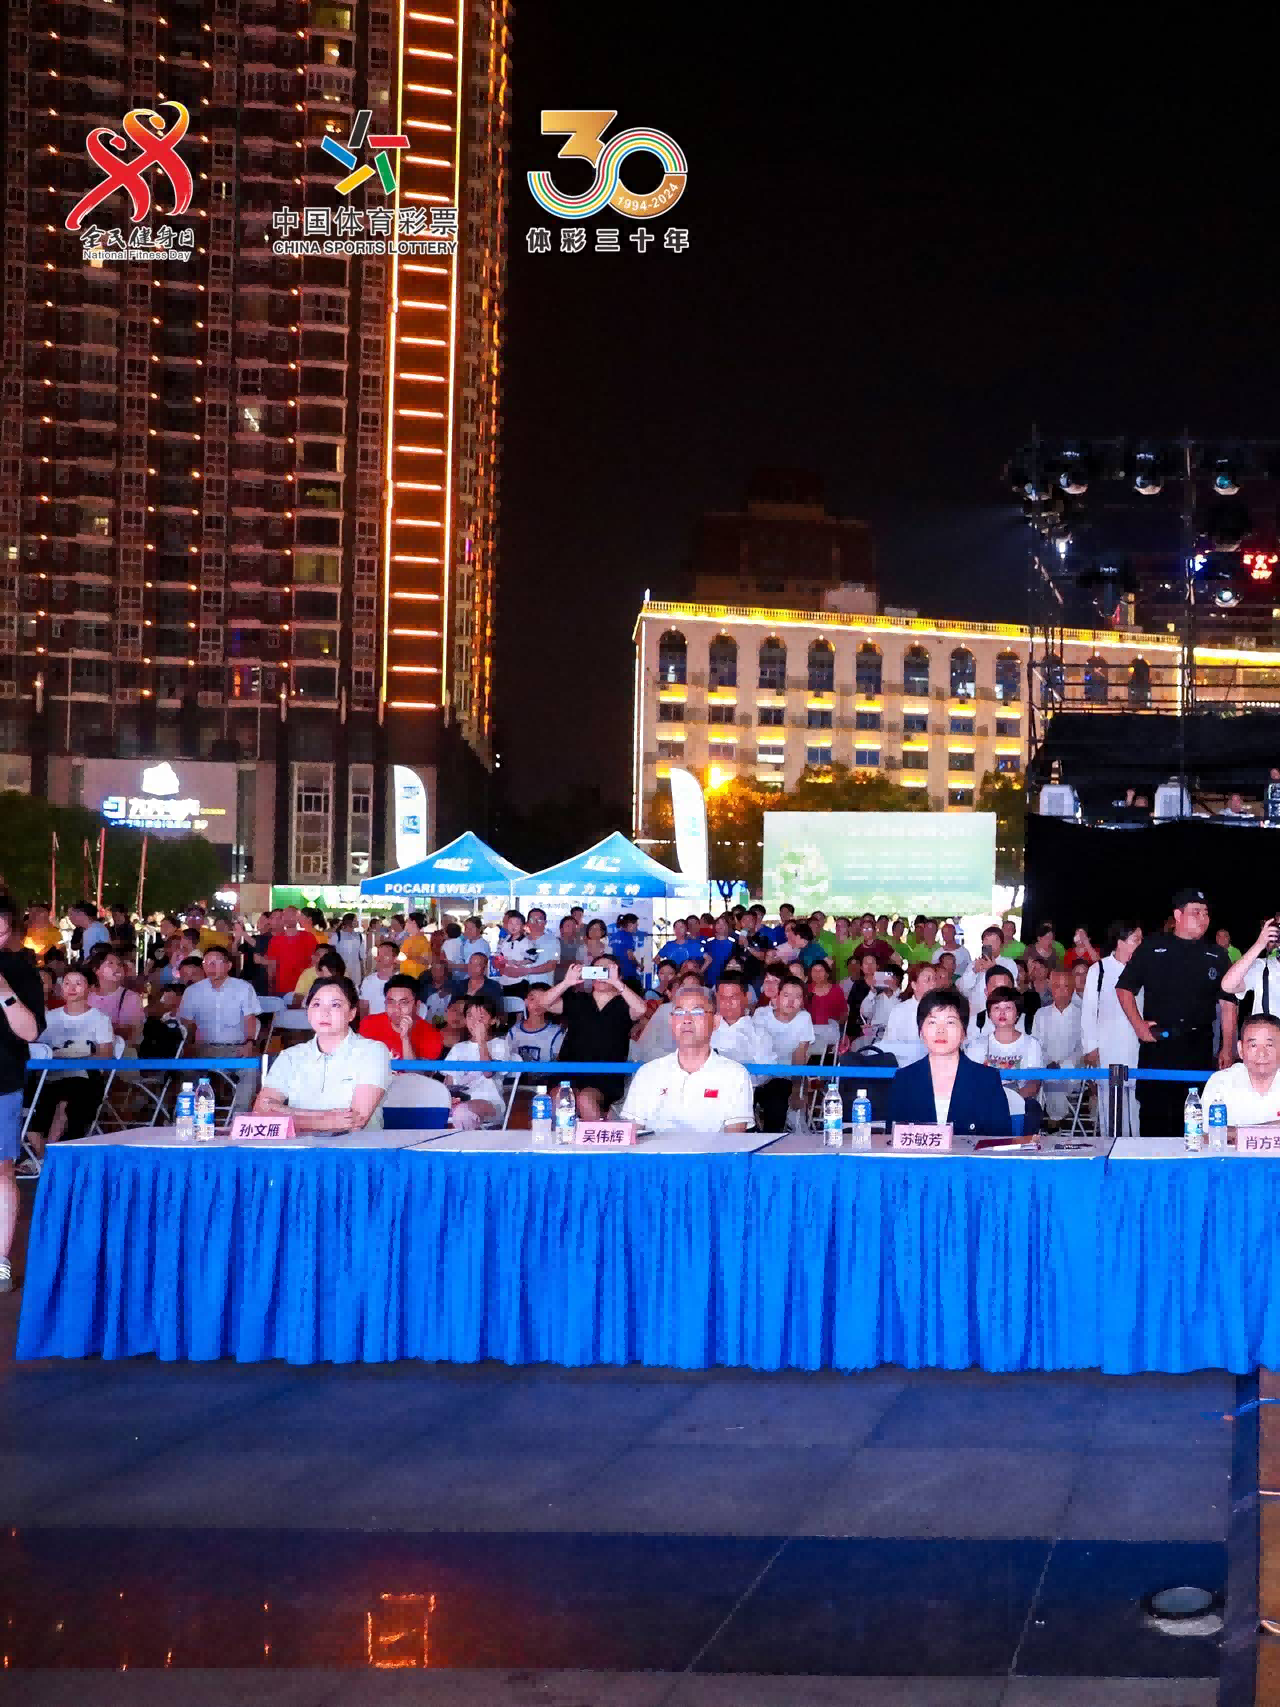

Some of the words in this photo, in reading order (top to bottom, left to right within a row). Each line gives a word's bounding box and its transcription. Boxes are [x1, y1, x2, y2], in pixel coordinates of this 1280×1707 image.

[384, 883, 435, 894] POCARI
[239, 1123, 281, 1137] 孙文雁
[582, 1129, 625, 1144] 吴伟辉
[900, 1132, 943, 1147] 苏敏芳
